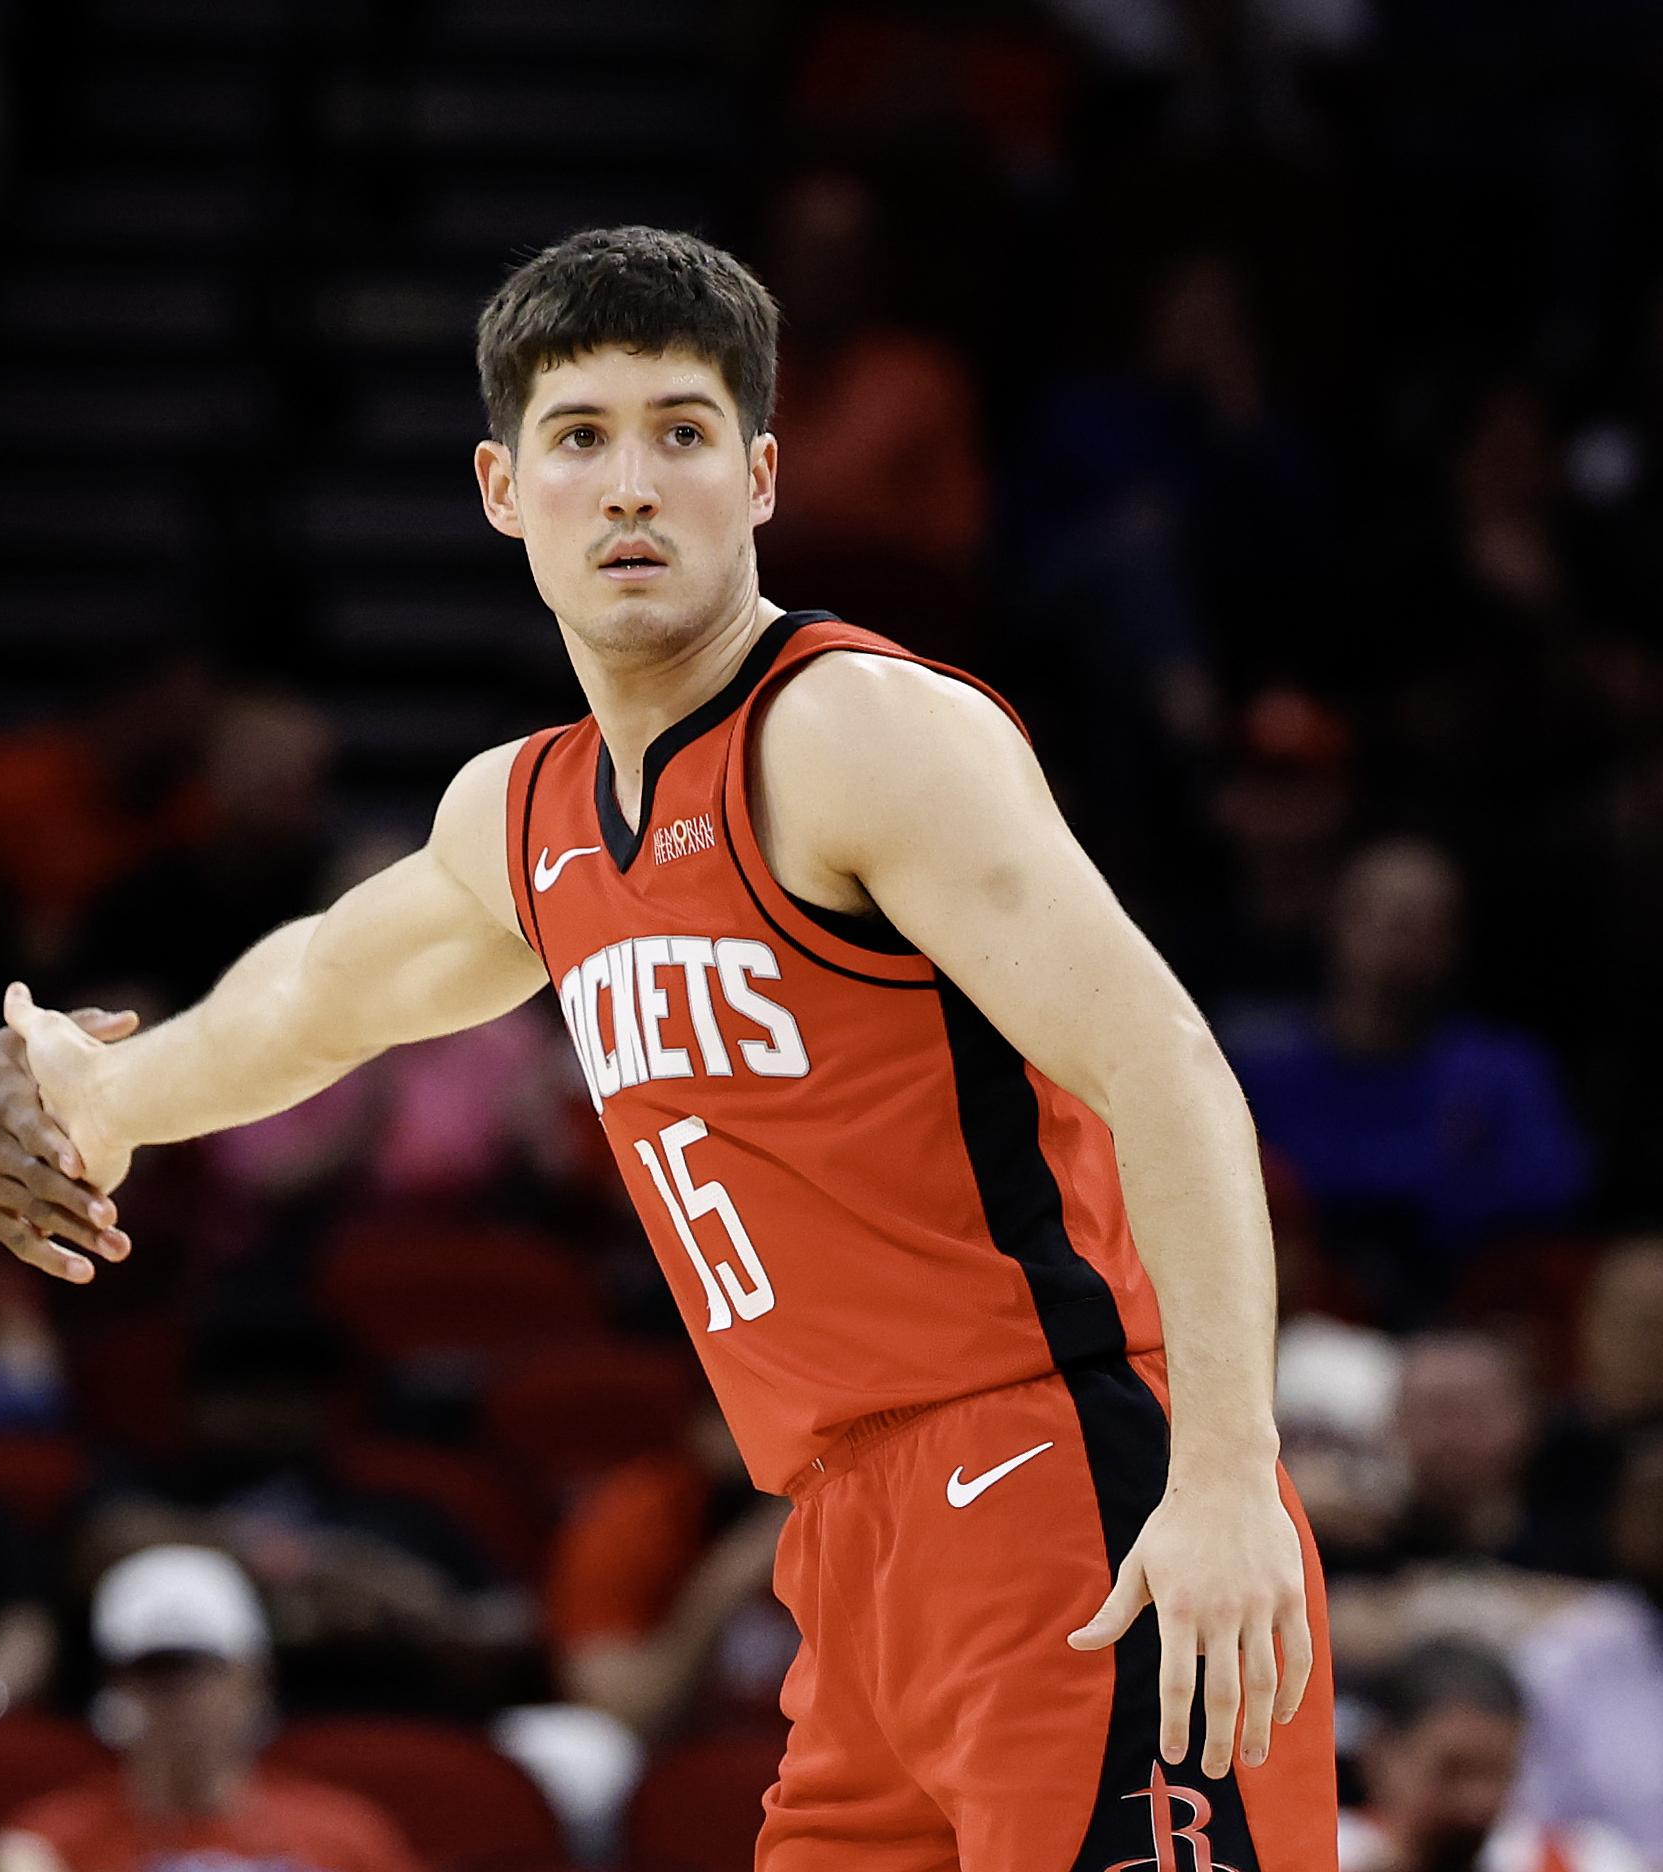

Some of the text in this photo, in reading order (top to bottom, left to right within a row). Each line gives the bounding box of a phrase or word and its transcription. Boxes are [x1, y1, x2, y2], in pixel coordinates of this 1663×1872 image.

[653, 814, 714, 846] MEMORIAL
[654, 830, 715, 865] HERMANN
[559, 936, 811, 1116] OCKETS
[633, 1115, 776, 1333] 15
